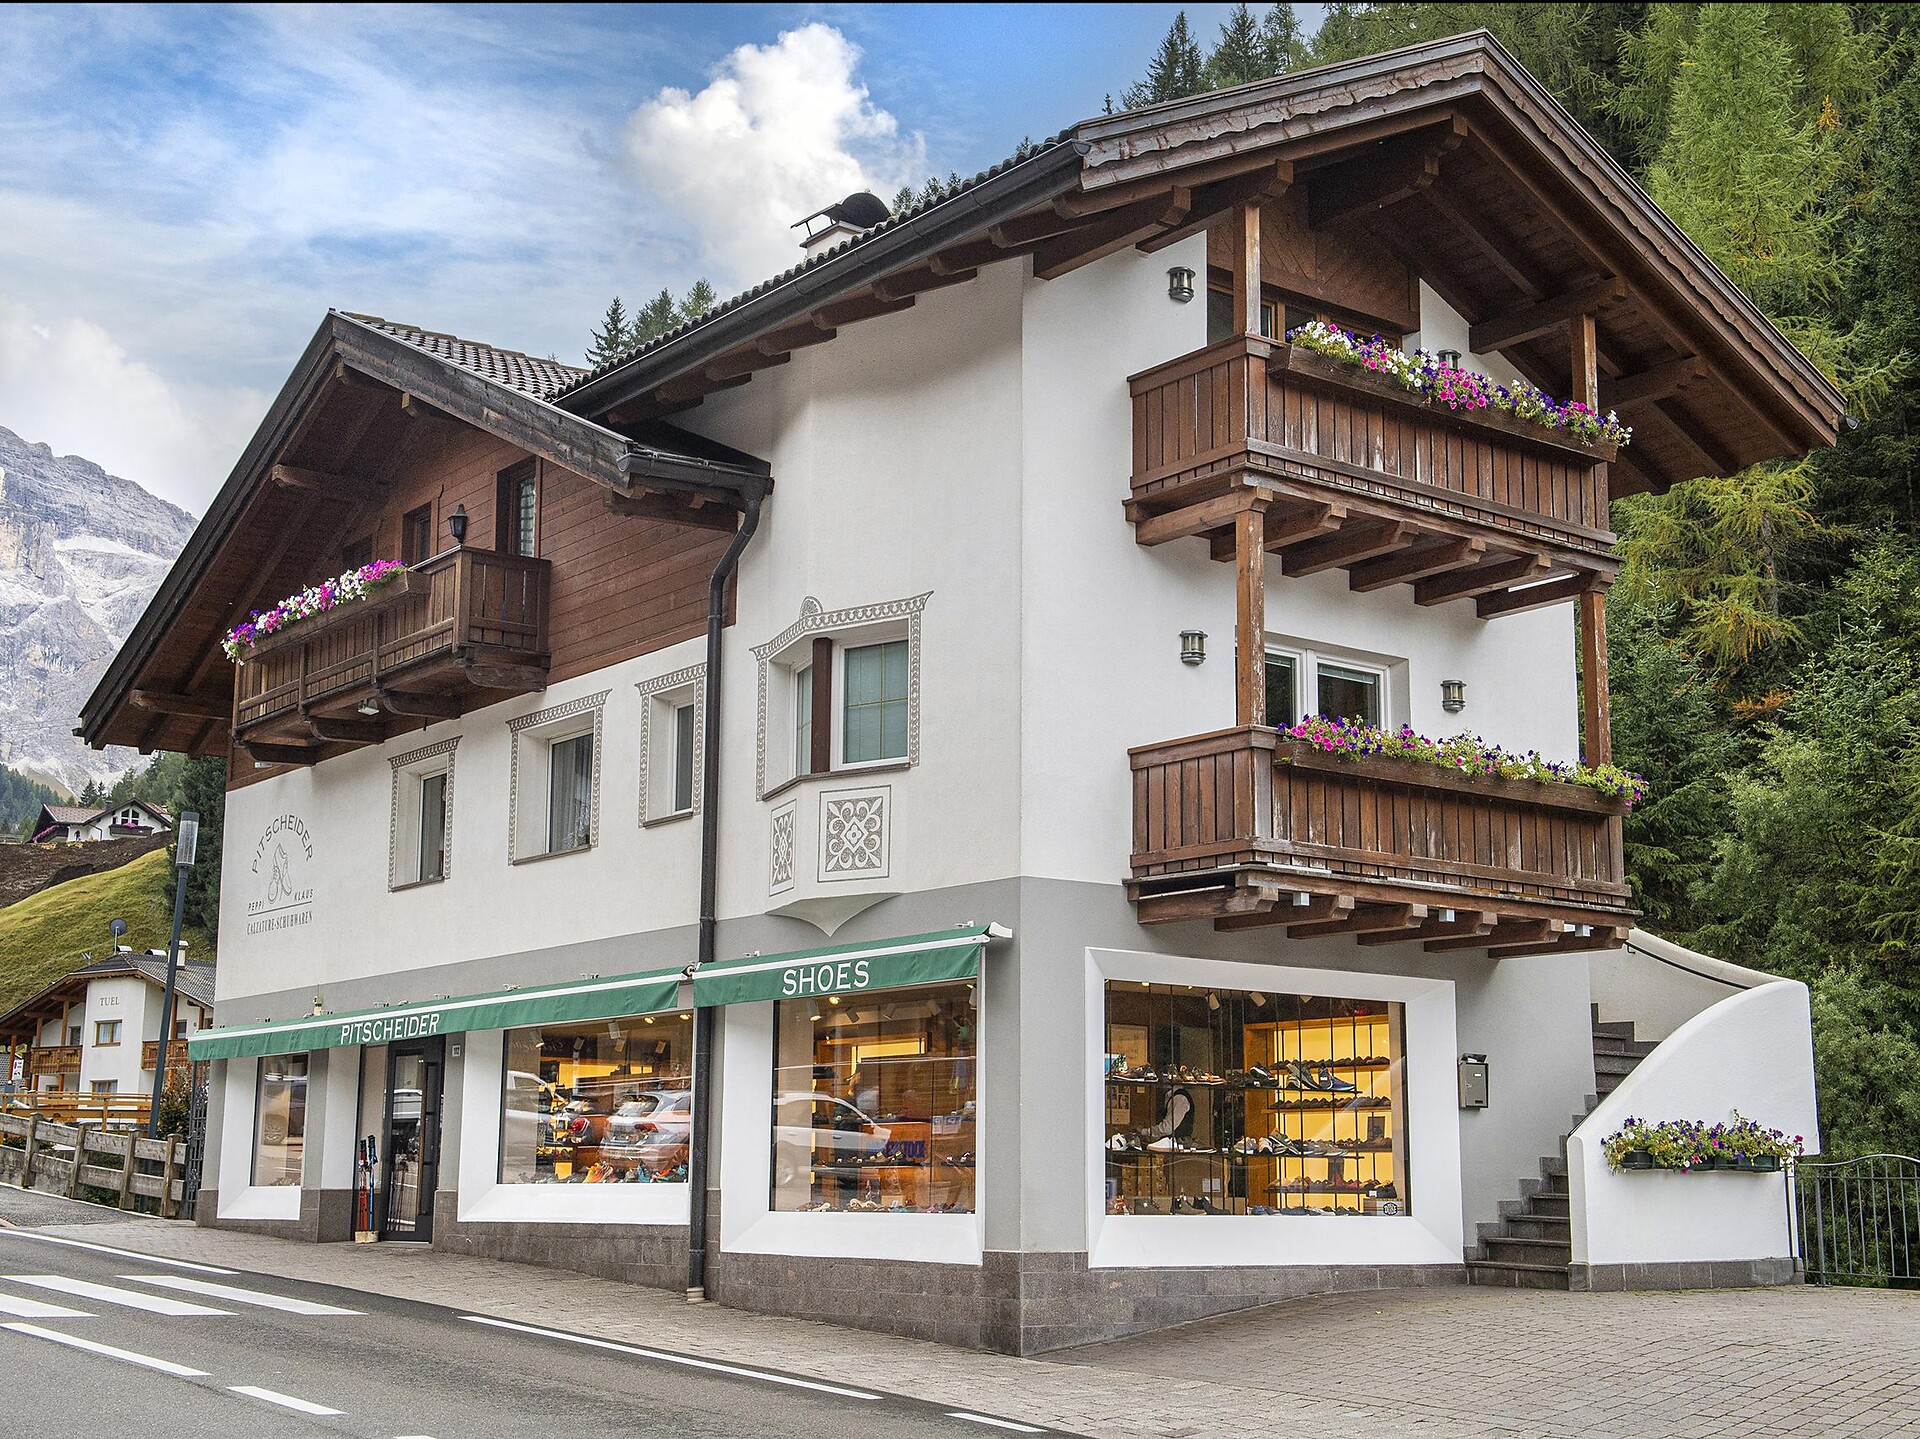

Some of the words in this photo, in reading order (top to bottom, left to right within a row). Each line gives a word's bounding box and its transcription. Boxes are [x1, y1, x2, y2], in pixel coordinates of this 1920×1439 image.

[252, 814, 313, 873] PITSCHEIDER
[248, 900, 264, 911] PEPPI
[294, 888, 313, 901] KLAUS
[782, 961, 869, 995] SHOES
[100, 996, 120, 1006] TUEL
[340, 1013, 440, 1045] PITSCHEIDER
